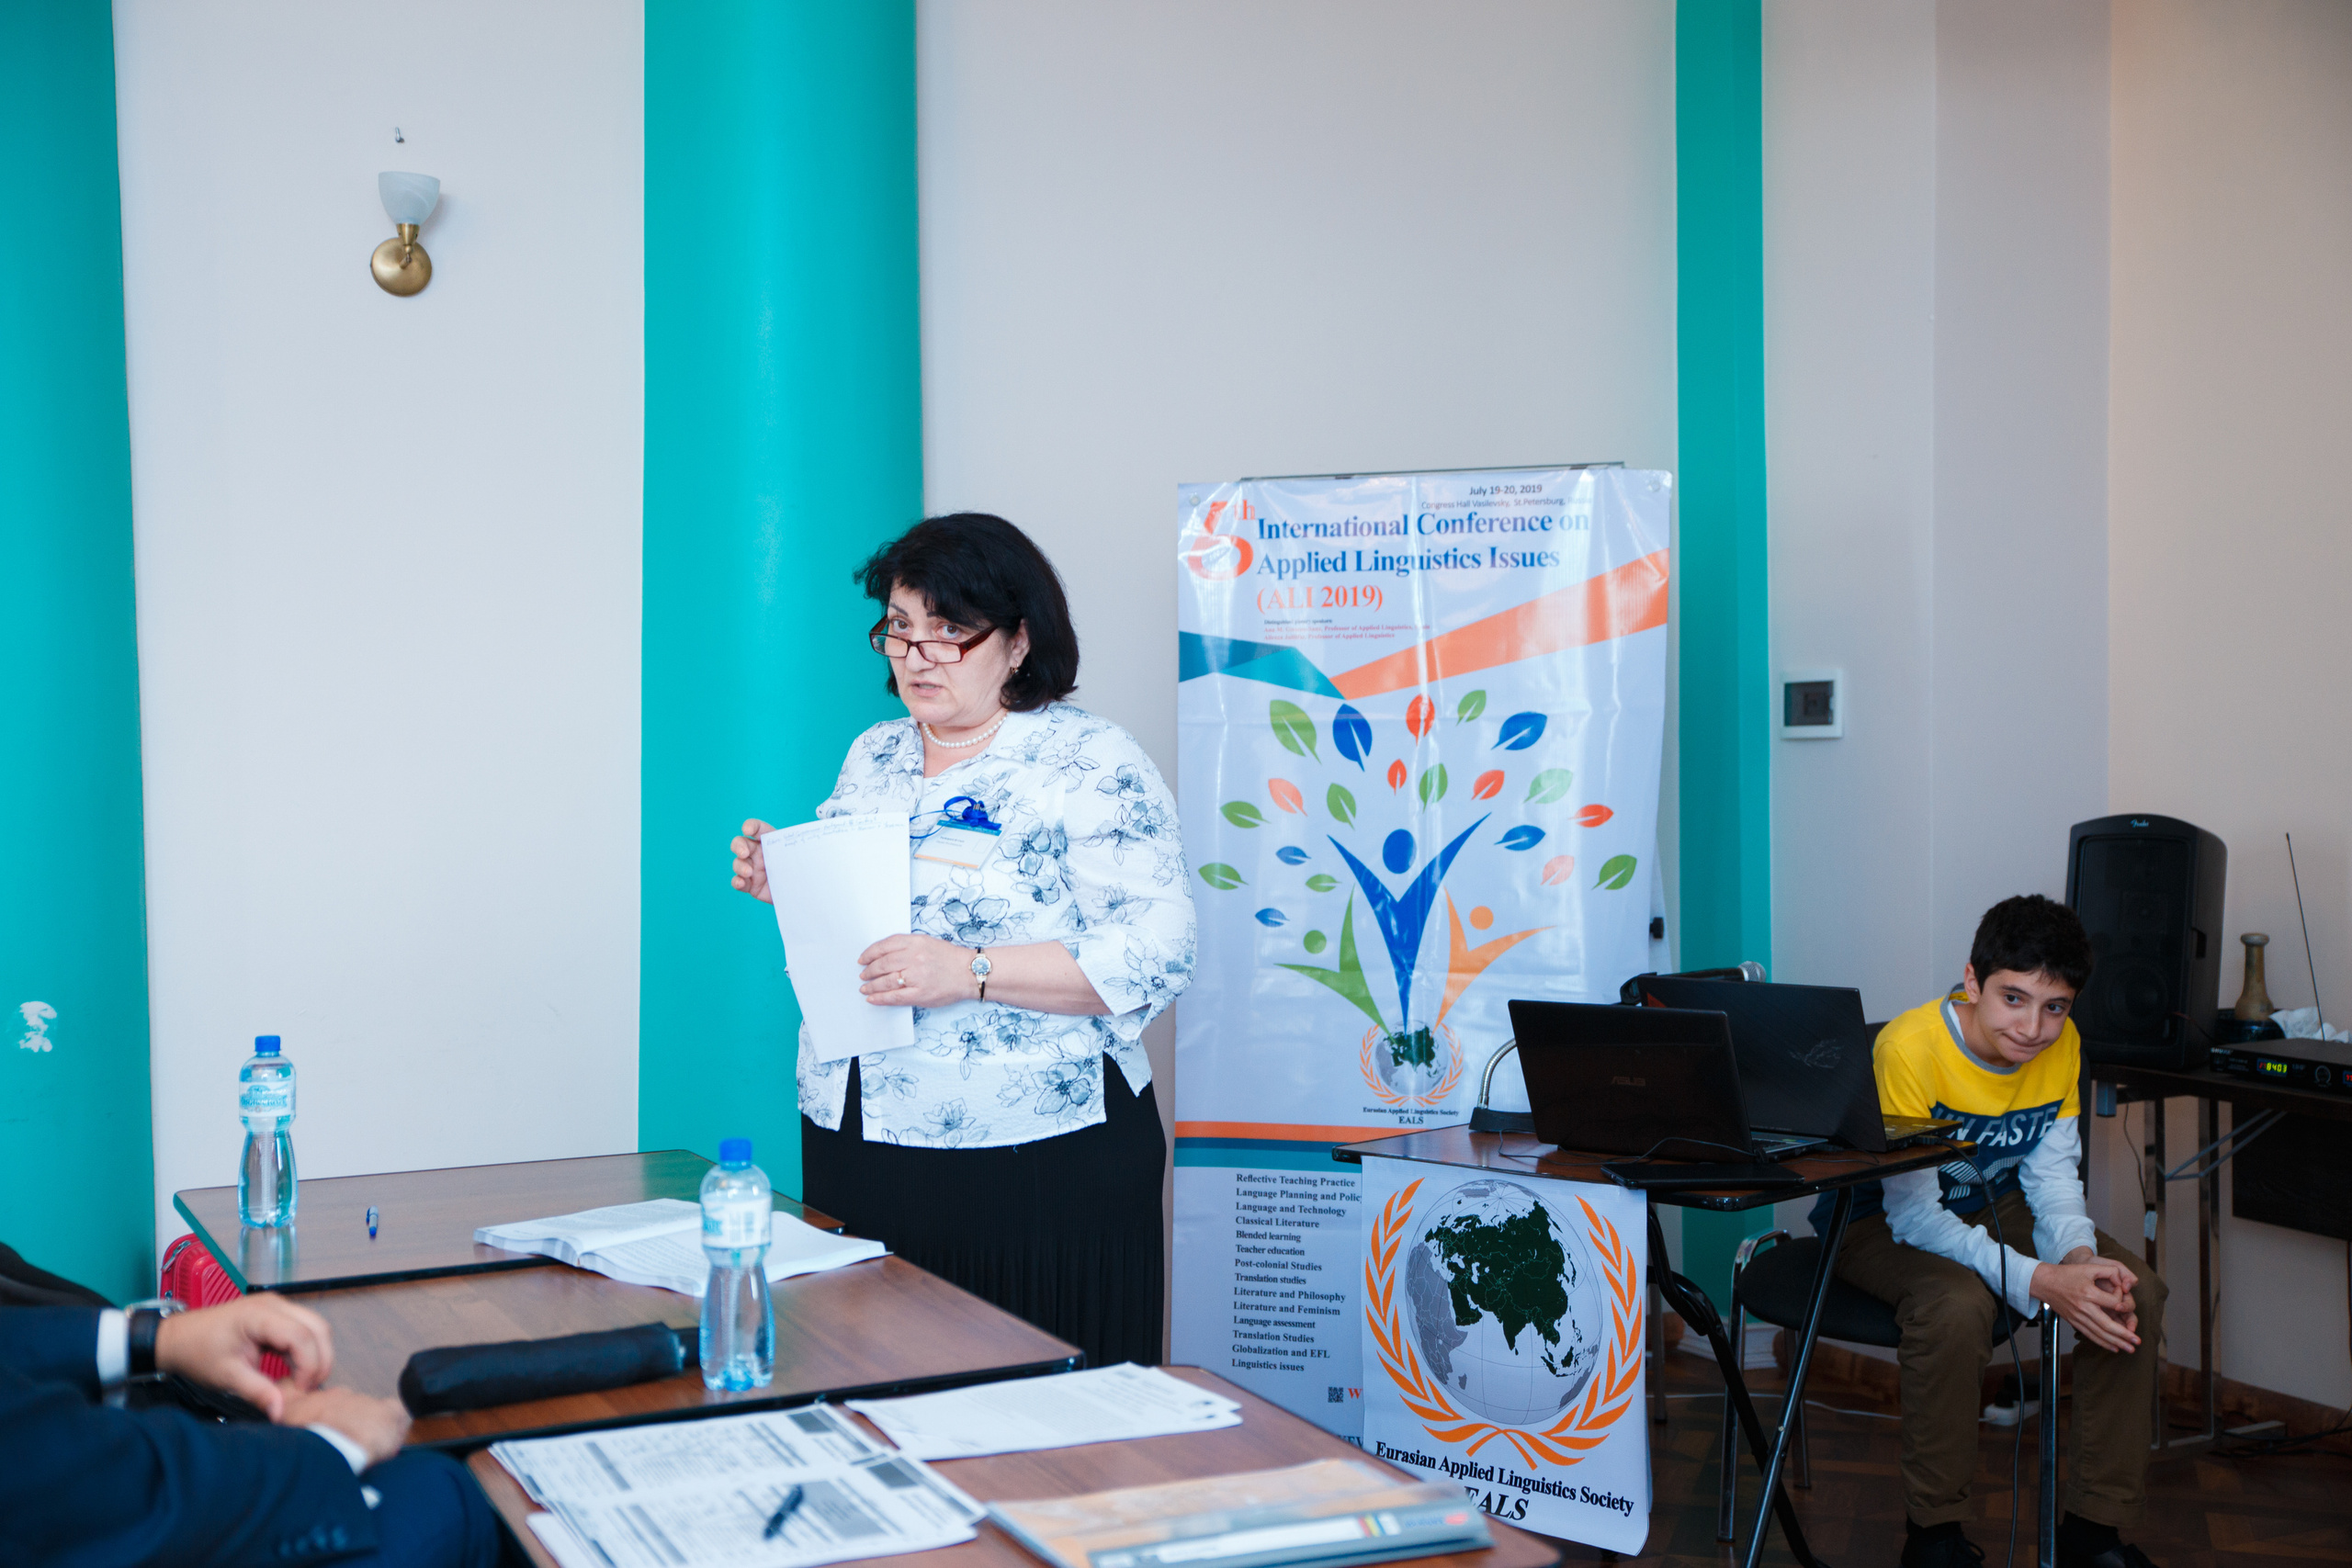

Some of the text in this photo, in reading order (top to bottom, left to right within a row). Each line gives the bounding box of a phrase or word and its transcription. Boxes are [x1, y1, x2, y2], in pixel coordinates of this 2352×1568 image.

[1469, 484, 1543, 497] July 19-20, 2019
[1421, 501, 1454, 510] Congress
[1456, 500, 1470, 508] Hall
[1472, 499, 1510, 509] Vasilevsky,
[1258, 511, 1590, 540] International Conference on
[1257, 546, 1561, 581] Applied Linguistics Issues
[1257, 584, 1383, 615] (ALI 2019)
[1398, 1116, 1424, 1124] EALS
[1440, 1109, 1459, 1117] Society
[1236, 1173, 1355, 1188] Reflective Teaching Practice
[1236, 1188, 1278, 1200] Language
[1280, 1190, 1317, 1201] Planning
[1320, 1192, 1337, 1201] and
[1236, 1201, 1347, 1217] Language and Technology
[1235, 1216, 1320, 1228] Classical Literature
[1236, 1230, 1301, 1243] Blended learning
[1235, 1244, 1306, 1257] Teacher education
[1235, 1258, 1323, 1271] Post-colonial Studies
[1235, 1272, 1306, 1285] Translation studies
[1234, 1287, 1346, 1303] Literature and Philosophy
[1233, 1301, 1341, 1316] Literature and Feminism
[1233, 1315, 1316, 1329] Language assessment
[1232, 1329, 1315, 1344] Translation Studies
[1232, 1344, 1330, 1359] Globalization and EFL
[1232, 1358, 1305, 1372] Linguistics issues
[1374, 1440, 1436, 1470] Eurasian
[1439, 1455, 1495, 1482] Applied
[1498, 1467, 1577, 1502] Linguistics
[1579, 1485, 1635, 1517] Society
